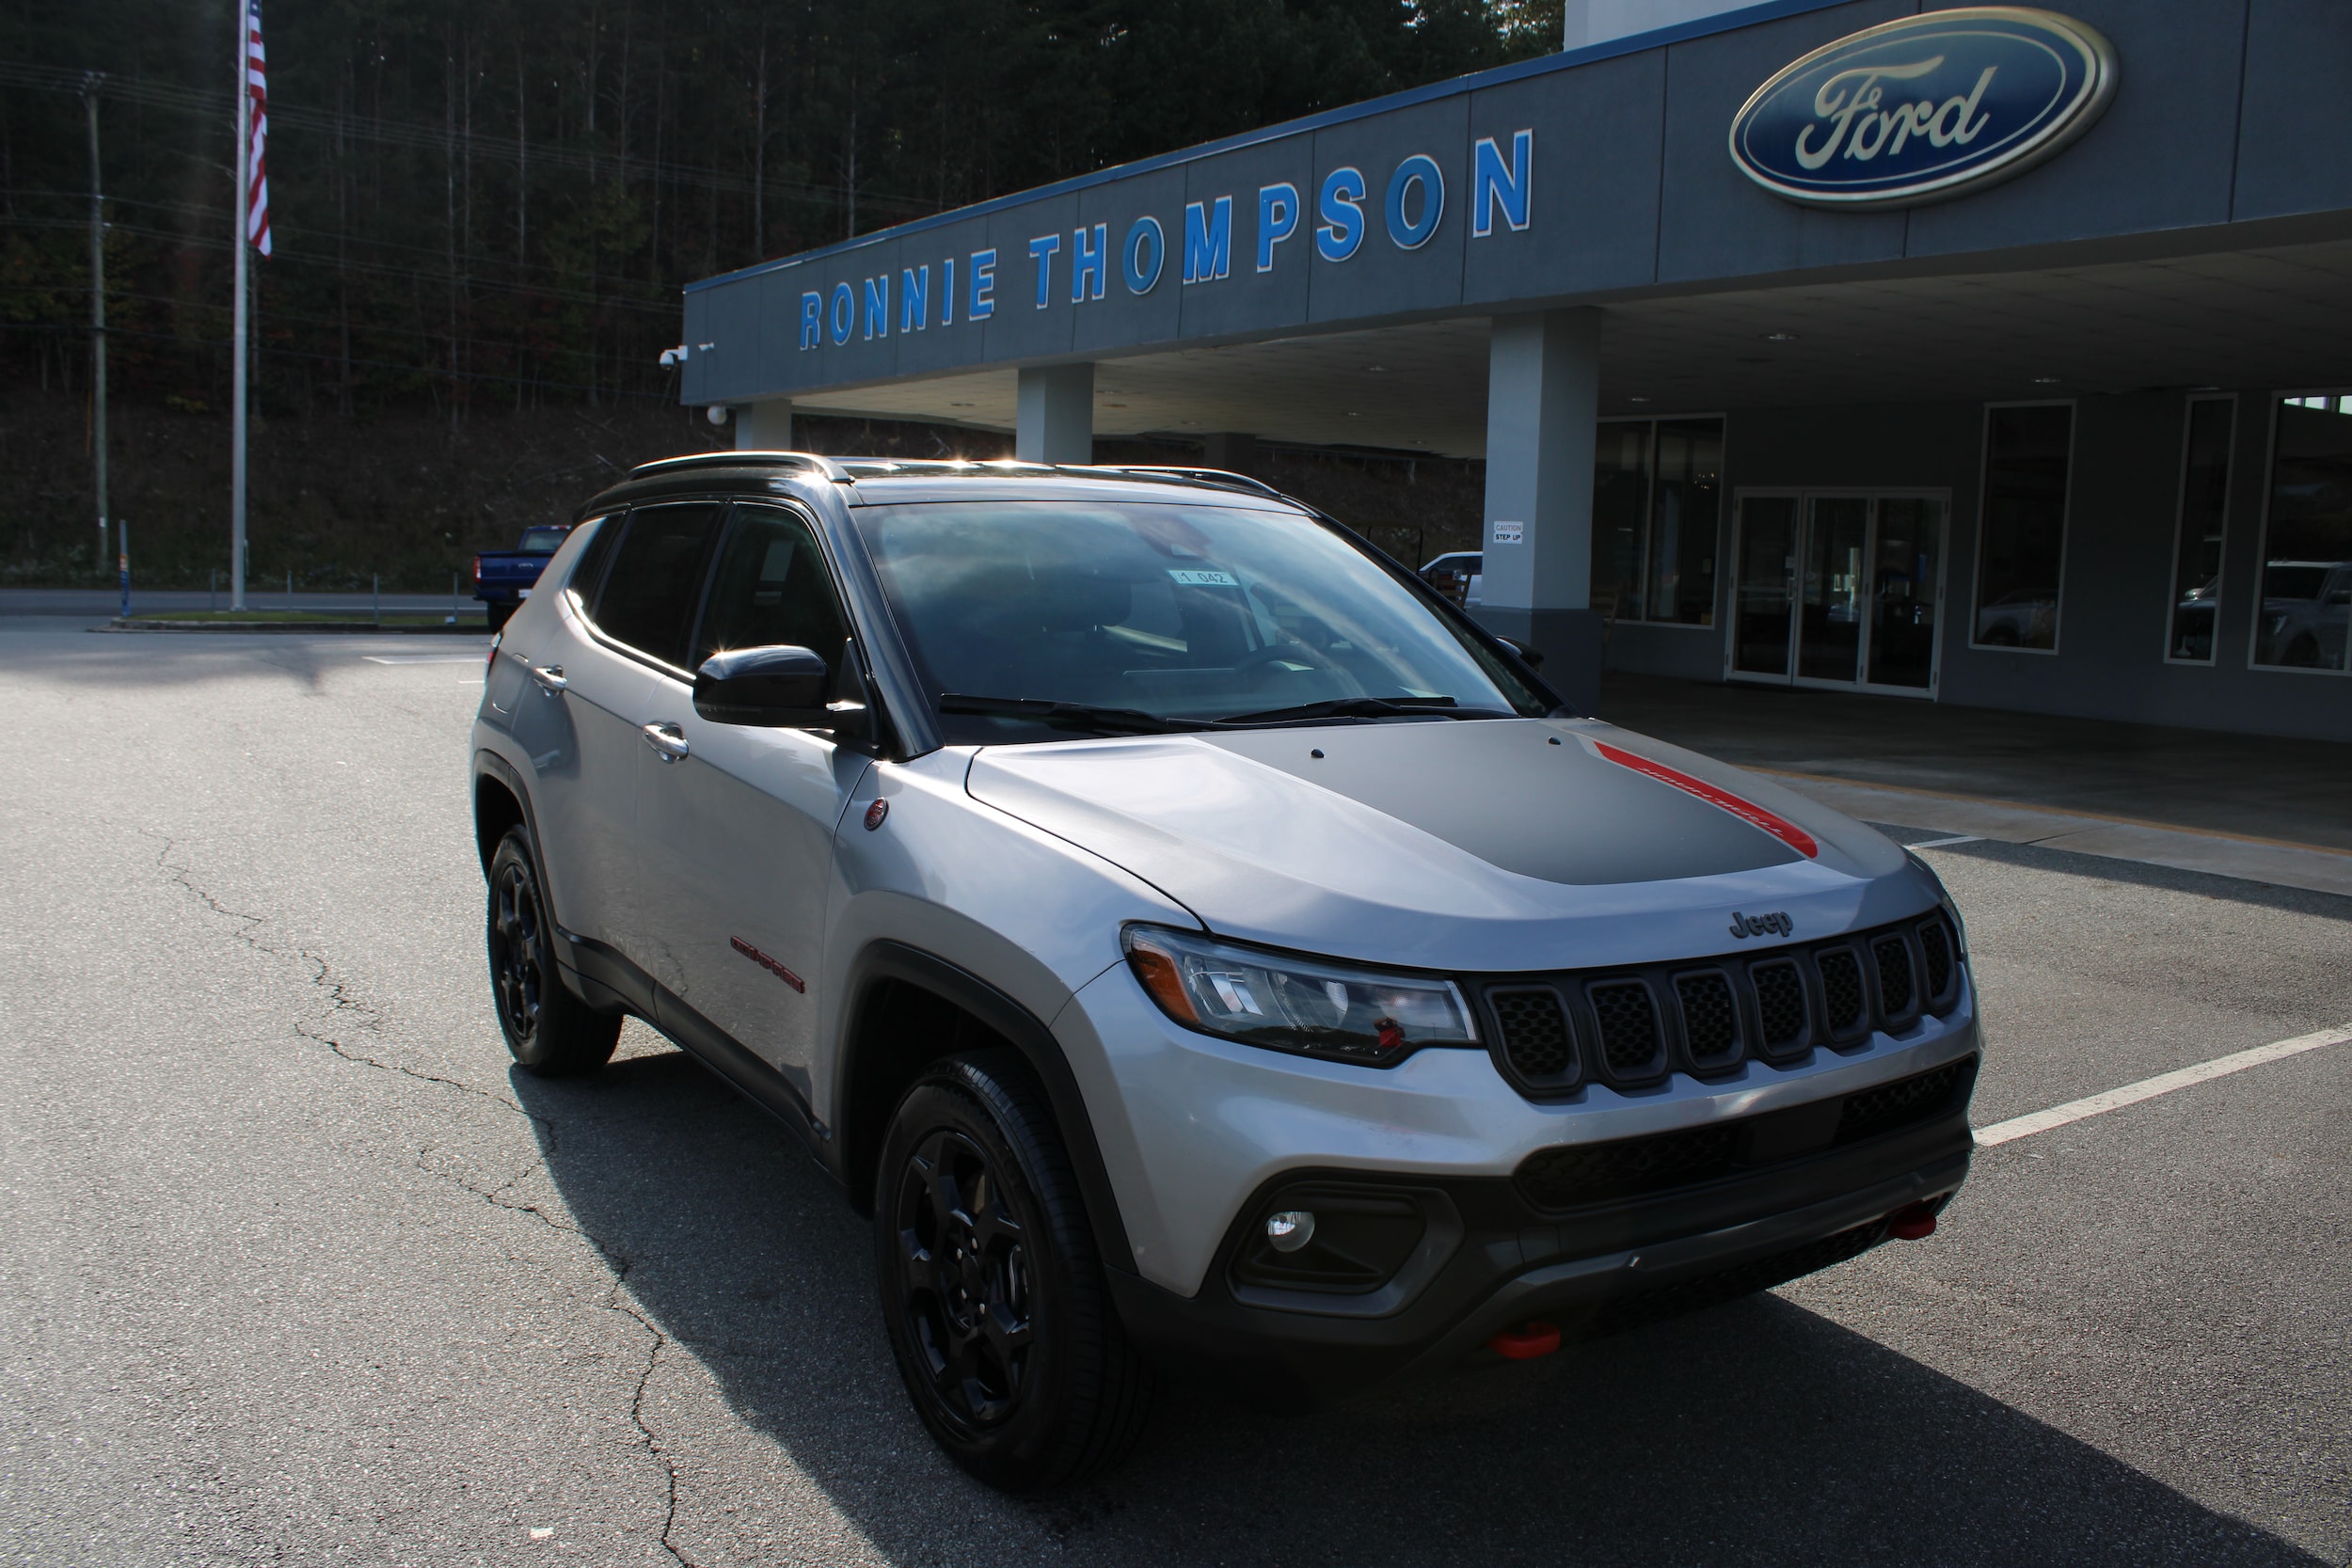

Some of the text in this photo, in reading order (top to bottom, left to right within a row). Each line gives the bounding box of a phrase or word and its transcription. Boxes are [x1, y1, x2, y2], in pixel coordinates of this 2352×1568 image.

[1795, 55, 1999, 170] Ford
[800, 129, 1534, 351] RONNIE THOMPSON
[1197, 572, 1228, 583] 042
[1729, 911, 1794, 939] Jeep
